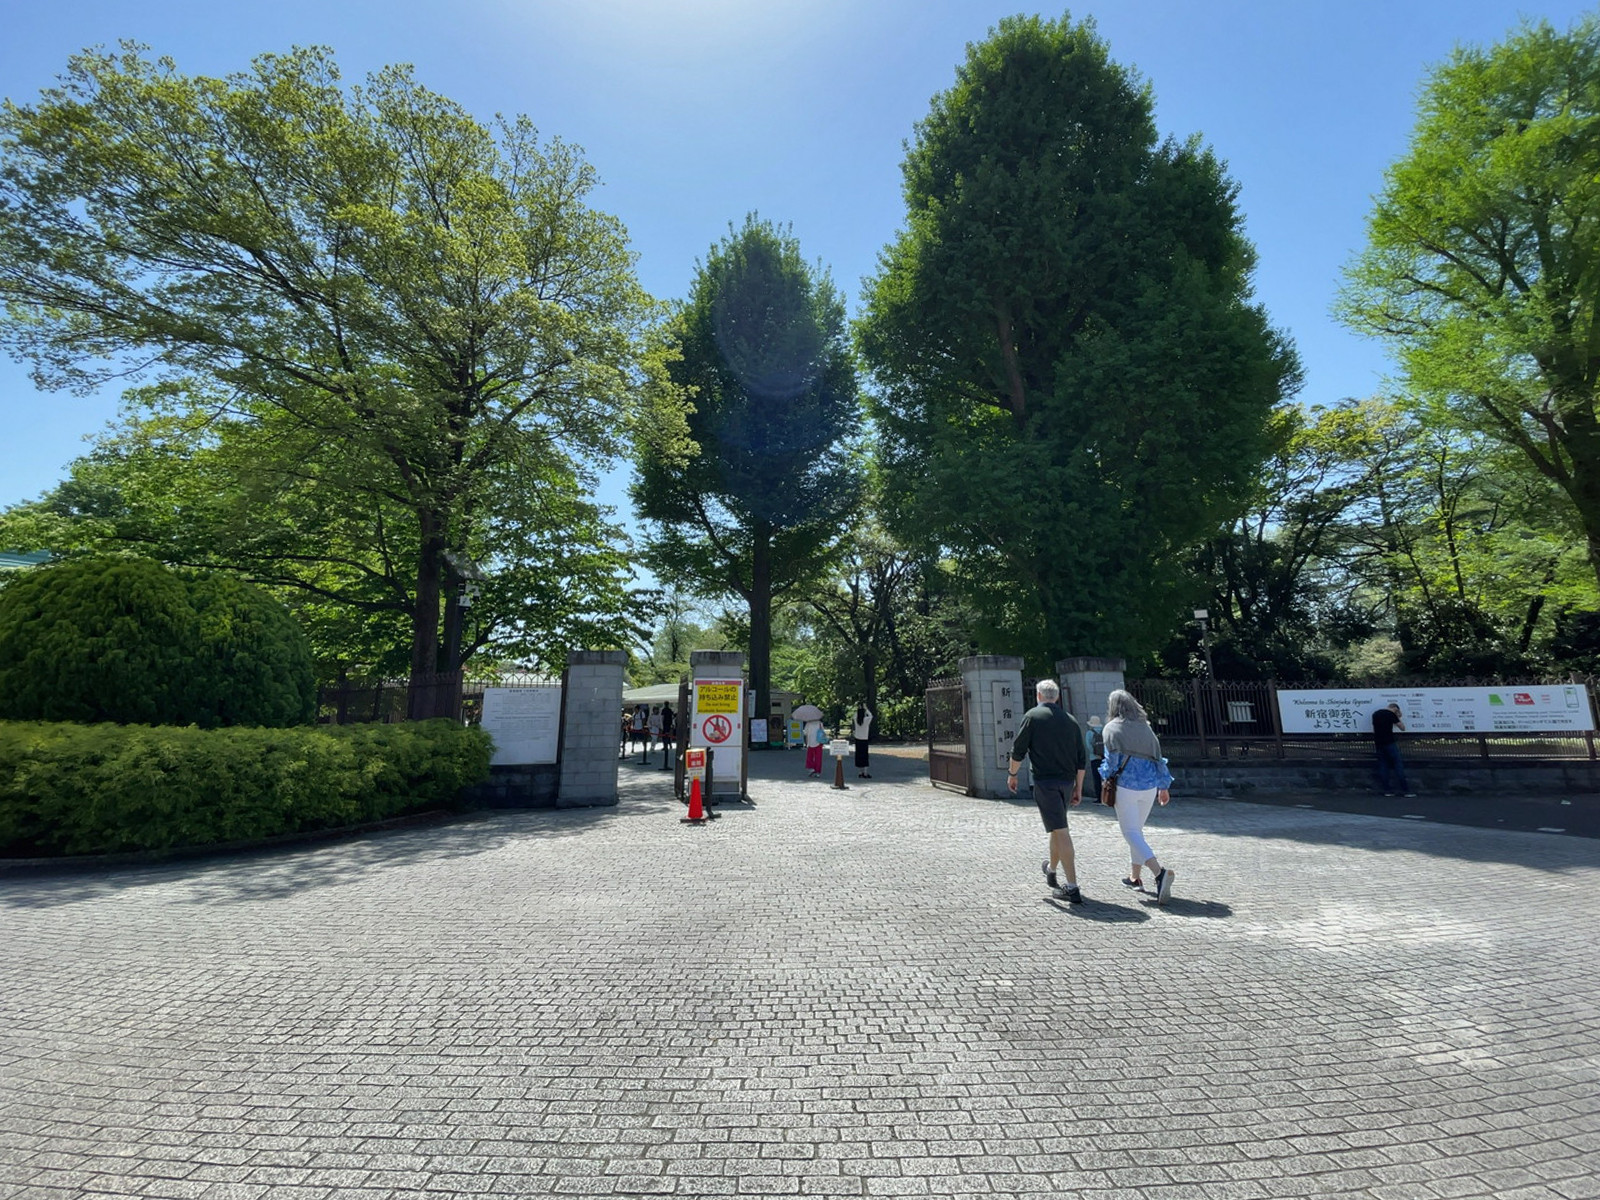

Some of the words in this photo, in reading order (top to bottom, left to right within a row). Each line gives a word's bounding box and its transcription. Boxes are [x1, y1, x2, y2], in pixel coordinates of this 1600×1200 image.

[1304, 708, 1364, 719] 新宿御苑へ
